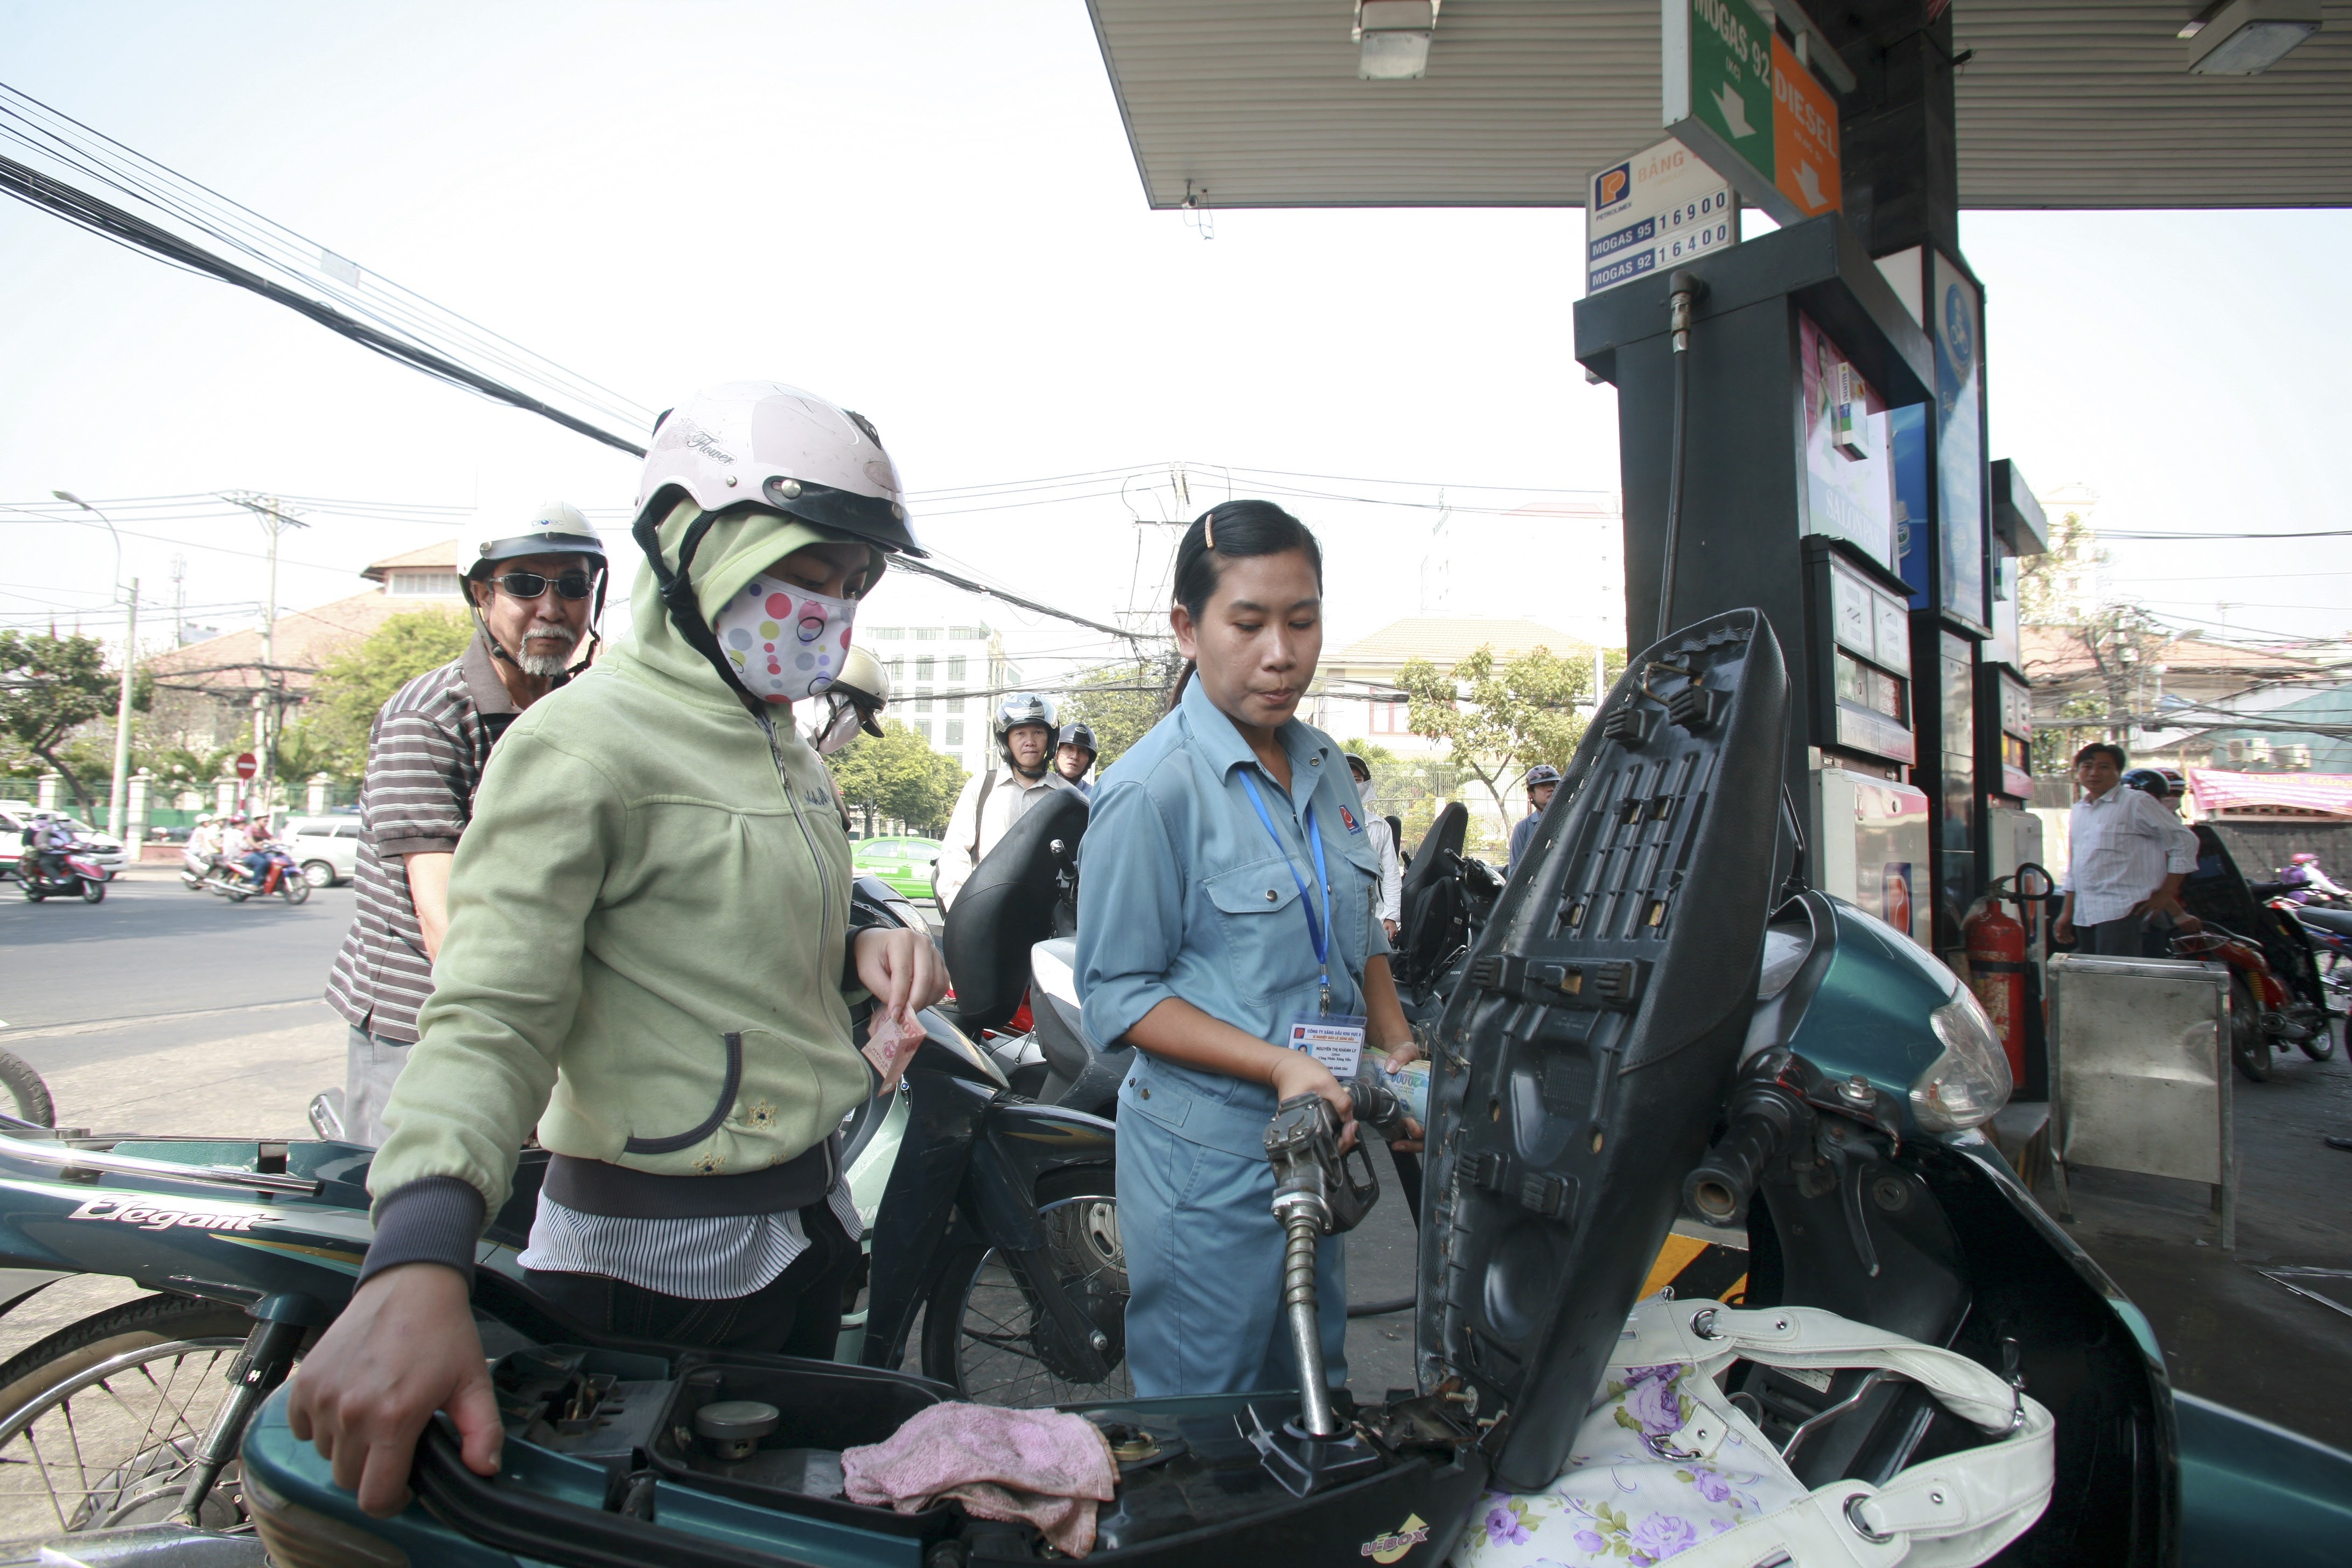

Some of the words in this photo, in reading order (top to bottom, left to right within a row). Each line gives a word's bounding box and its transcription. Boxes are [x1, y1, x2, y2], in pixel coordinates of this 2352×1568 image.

[1752, 40, 1770, 89] 92
[1775, 67, 1837, 159] DIESEL
[1638, 151, 1684, 183] BẢNG
[1592, 230, 1633, 256] MOGAS
[1637, 223, 1651, 238] 95
[1660, 192, 1725, 229] 16900
[1596, 201, 1633, 221] PETROLIMEX
[1592, 262, 1633, 286] MOGAS
[1637, 256, 1651, 269] 92
[1659, 225, 1726, 262] 16400
[687, 431, 734, 464] Flower
[67, 1193, 286, 1231] Elegant
[1361, 1527, 1430, 1556] U-BOX
